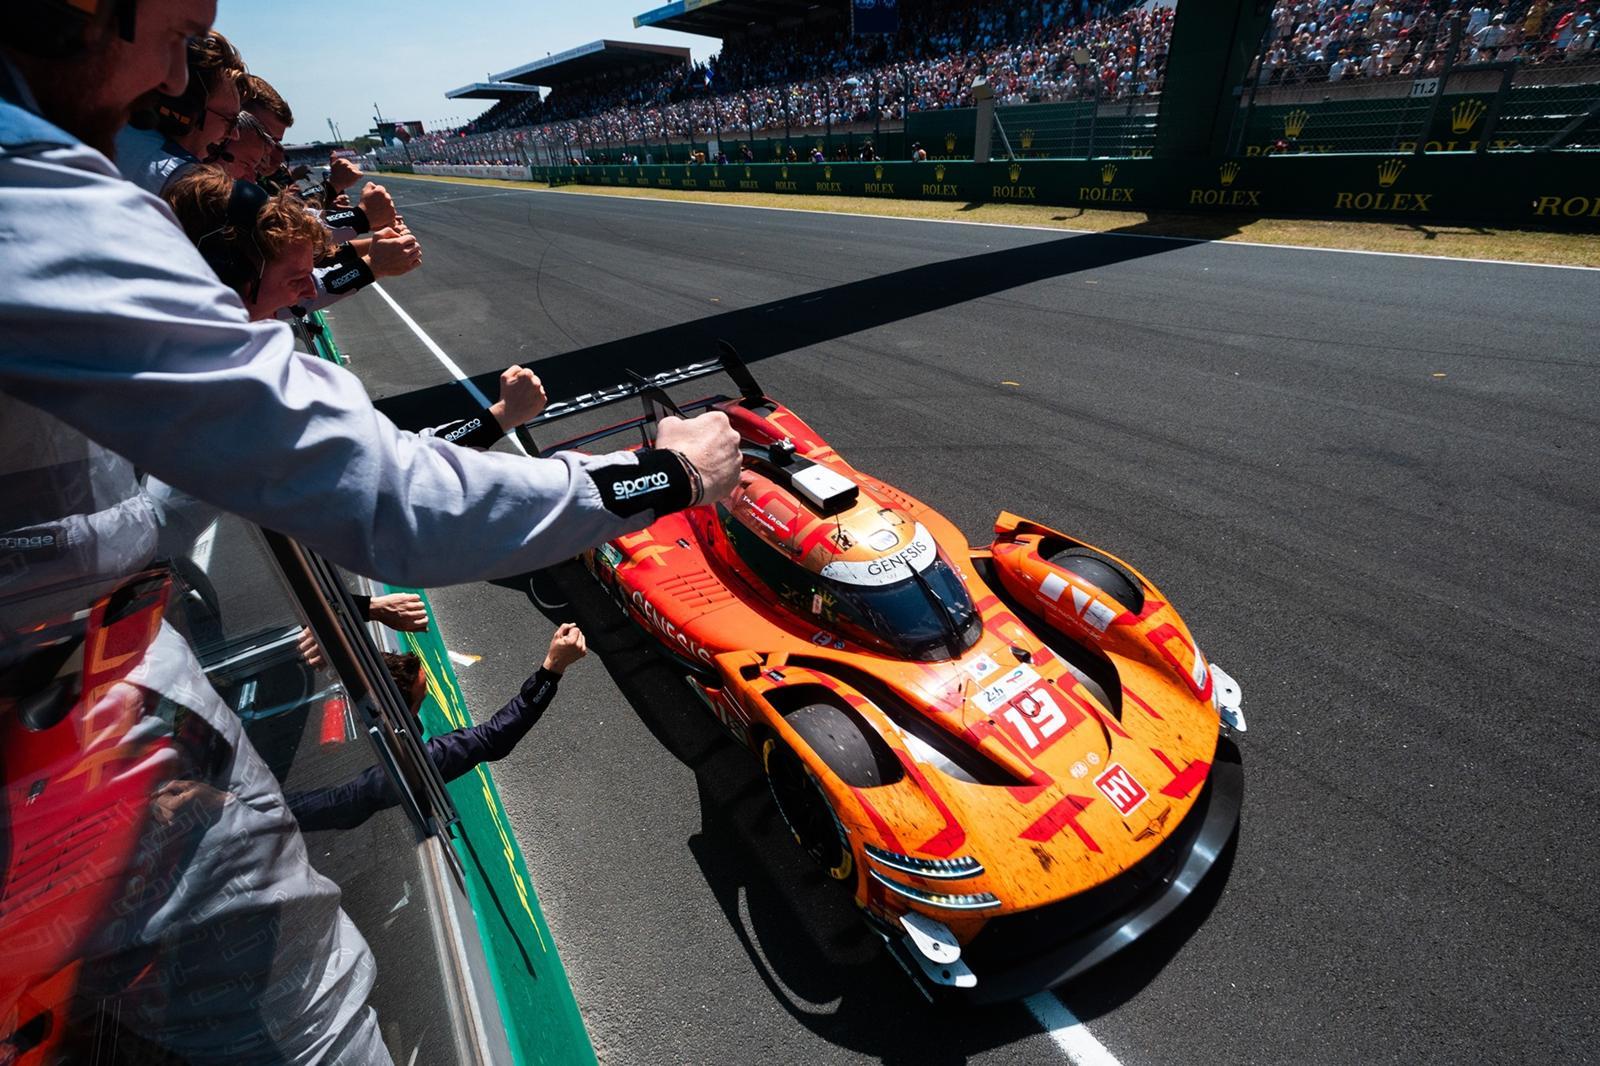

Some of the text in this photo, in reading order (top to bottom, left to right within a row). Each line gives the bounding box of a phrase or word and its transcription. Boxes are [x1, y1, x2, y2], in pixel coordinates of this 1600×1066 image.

[1413, 81, 1437, 95] T1.2
[816, 182, 842, 193] ROLEX
[863, 183, 895, 194] ROLEX
[922, 184, 959, 197] ROLEX
[992, 185, 1037, 199] ROLEX
[1080, 187, 1136, 203] ROLEX
[1189, 189, 1262, 206] ROLEX
[1334, 192, 1432, 211] ROLEX
[444, 418, 483, 441] sparco
[612, 471, 671, 500] sparco
[867, 541, 928, 576] GENESIS
[1003, 688, 1067, 749] 19
[1101, 769, 1139, 808] HY
